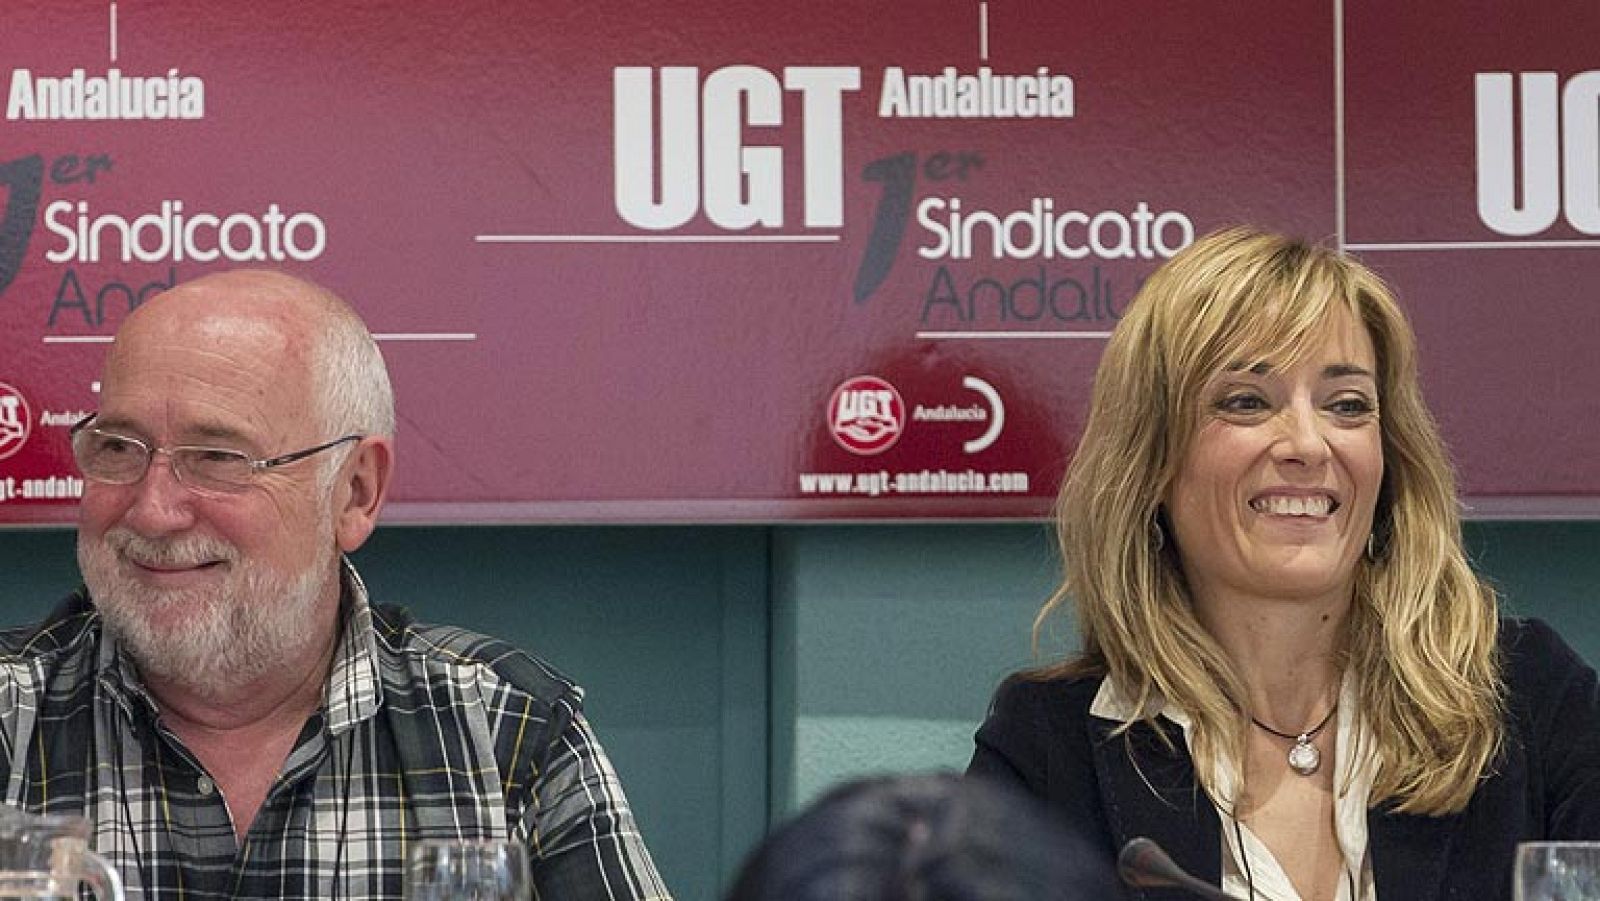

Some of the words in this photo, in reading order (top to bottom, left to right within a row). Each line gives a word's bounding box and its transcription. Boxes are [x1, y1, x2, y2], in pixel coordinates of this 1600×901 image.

[7, 68, 205, 120] Andalucía
[879, 66, 1074, 118] Andalucía
[613, 65, 861, 230] UGT
[45, 200, 326, 262] Sindicato
[917, 197, 1194, 260] Sindicato
[839, 390, 893, 420] UGT
